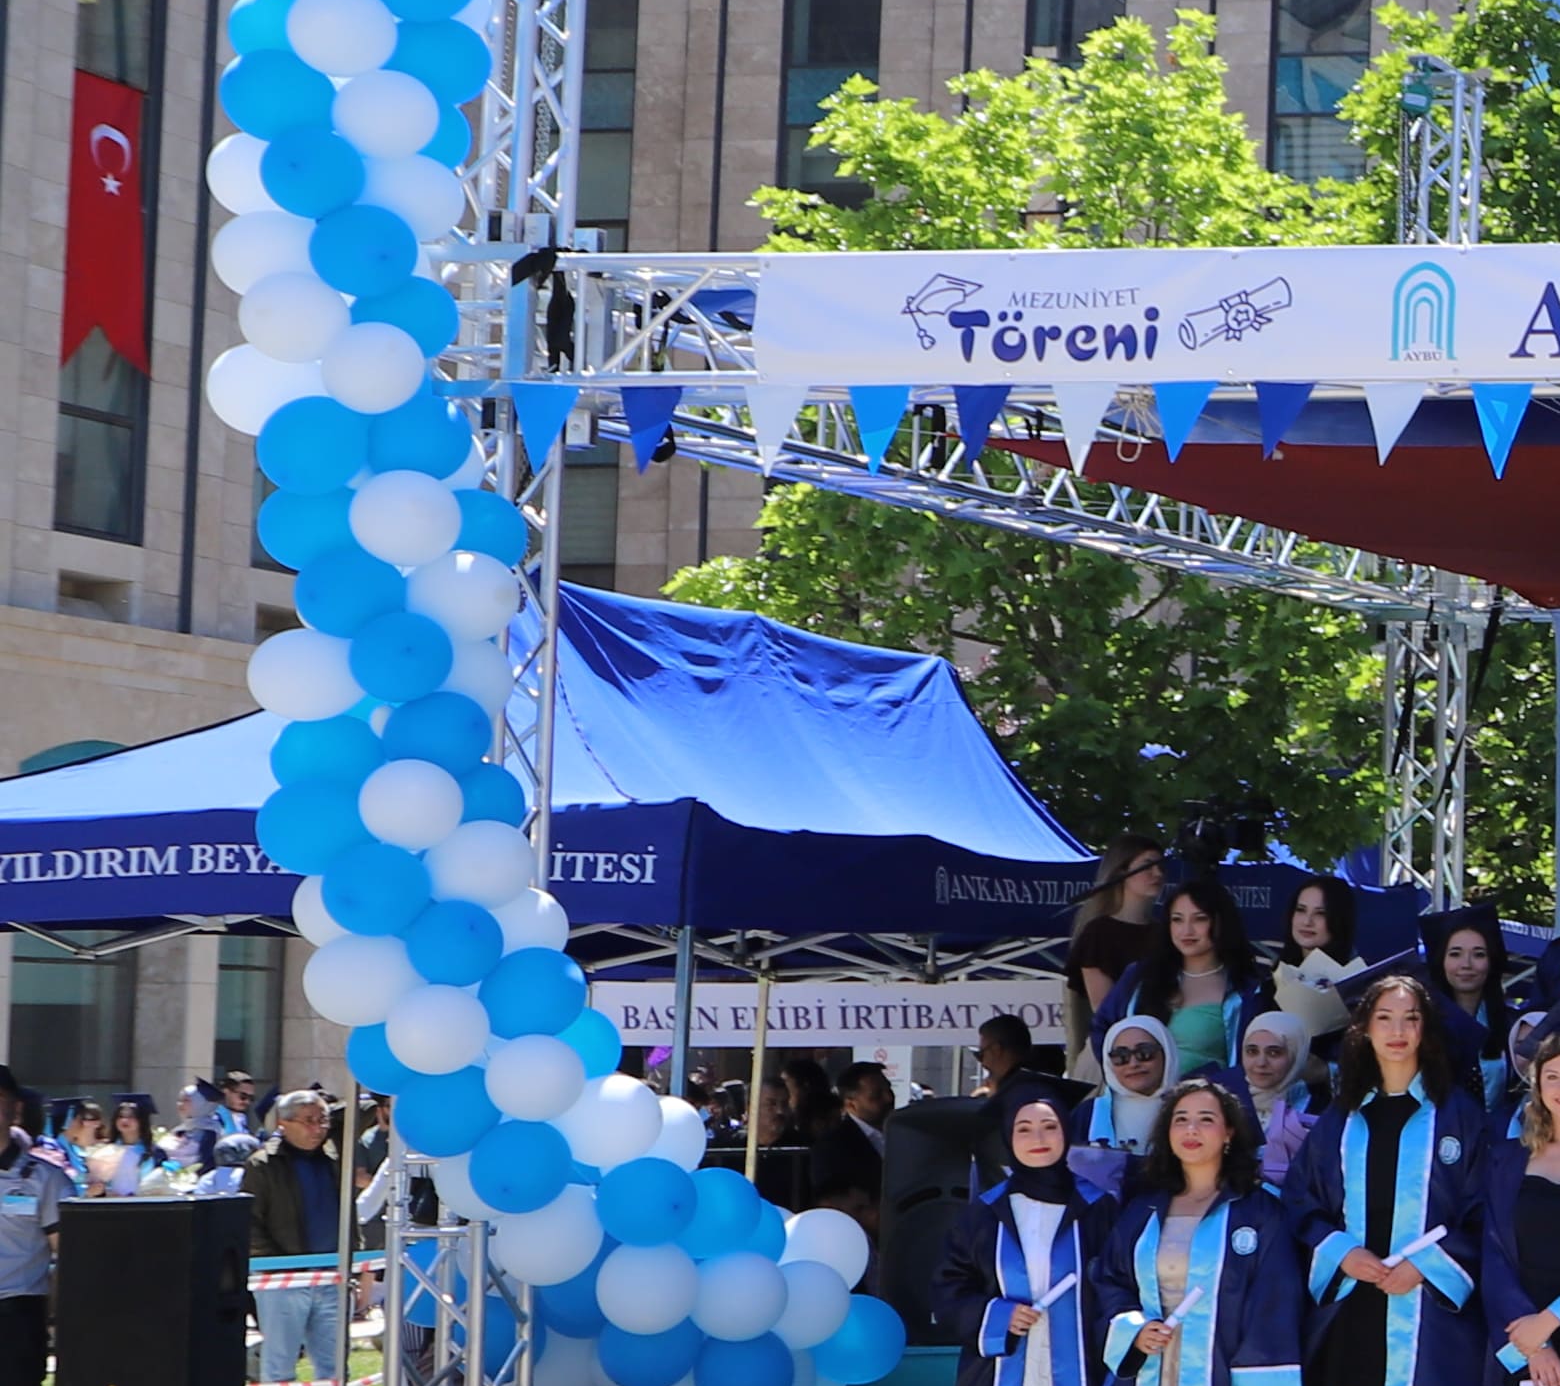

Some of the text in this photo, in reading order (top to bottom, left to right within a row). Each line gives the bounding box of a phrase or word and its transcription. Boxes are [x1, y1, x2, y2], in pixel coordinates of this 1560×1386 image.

[1007, 287, 1141, 311] MEZUNİYET
[947, 307, 1160, 364] Töreni
[951, 874, 1034, 905] ANKARA
[621, 1004, 719, 1031] BASN
[837, 996, 980, 1030] İRTİBAT
